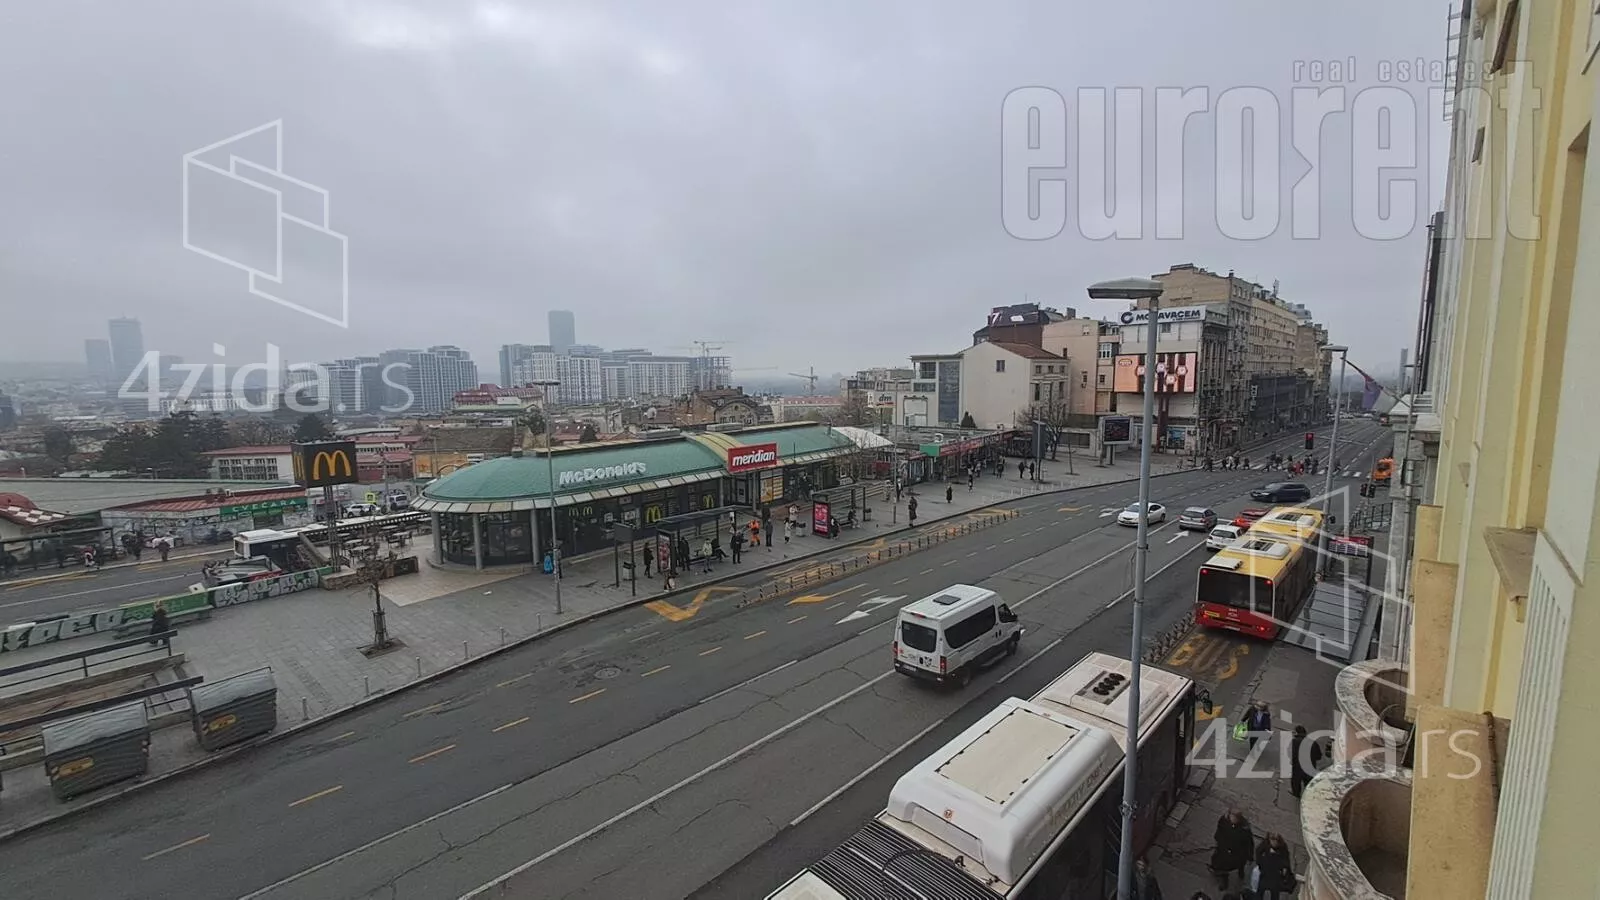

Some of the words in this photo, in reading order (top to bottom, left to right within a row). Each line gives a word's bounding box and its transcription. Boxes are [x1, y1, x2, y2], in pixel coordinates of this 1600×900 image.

[1136, 309, 1201, 321] MOAVACEM
[878, 394, 892, 402] dm
[732, 450, 775, 466] meridian
[559, 461, 647, 485] McDonald's
